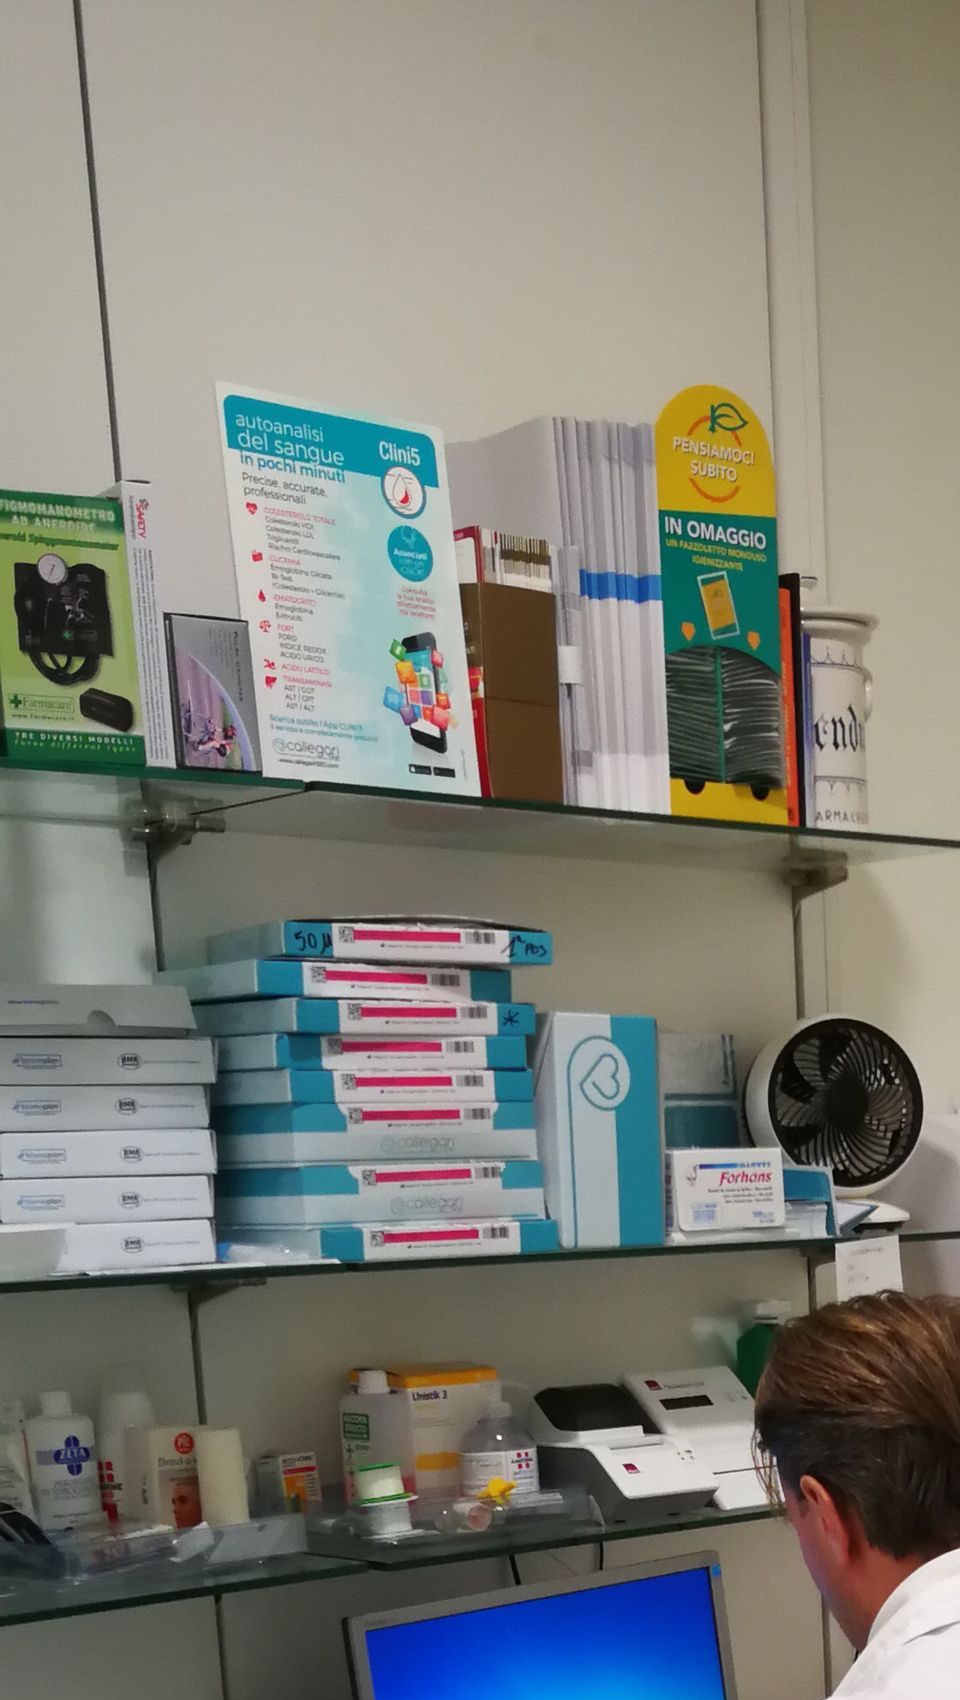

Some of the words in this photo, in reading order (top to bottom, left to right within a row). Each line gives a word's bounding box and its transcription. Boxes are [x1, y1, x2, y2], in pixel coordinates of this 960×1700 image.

[235, 414, 323, 443] autoanalisi
[237, 428, 268, 451] del
[274, 439, 344, 466] sangue
[379, 440, 421, 467] Clini5
[673, 437, 755, 465] PENSIAMOCI
[240, 450, 254, 466] in
[257, 455, 297, 474] pochi
[300, 465, 345, 484] minuti
[690, 460, 737, 482] SUBITO
[665, 516, 682, 535] IN
[687, 520, 767, 550] OMAGGIO
[40, 732, 83, 743] DIVERSI
[88, 736, 134, 746] MODELLI
[719, 1170, 772, 1187] Forhans
[442, 1389, 448, 1399] 3
[59, 1449, 86, 1460] ZETA
